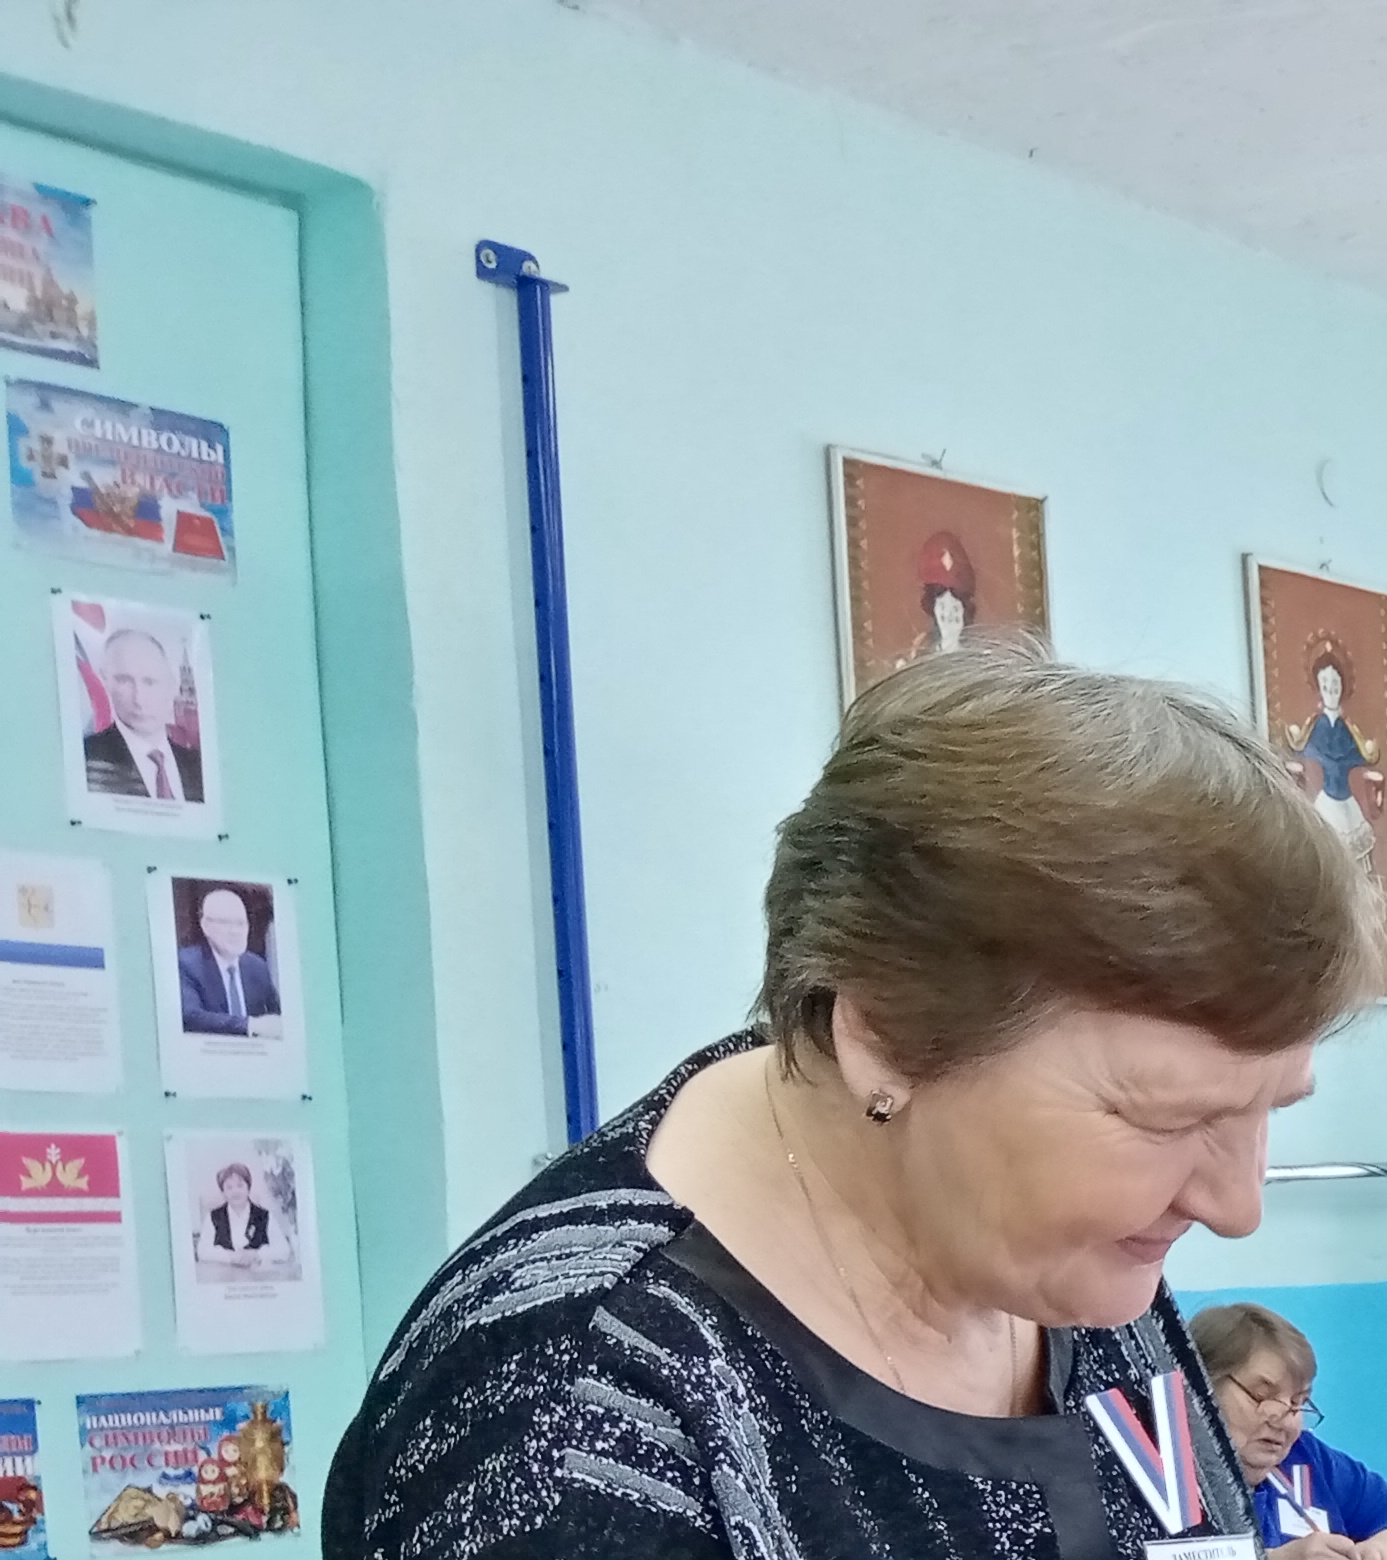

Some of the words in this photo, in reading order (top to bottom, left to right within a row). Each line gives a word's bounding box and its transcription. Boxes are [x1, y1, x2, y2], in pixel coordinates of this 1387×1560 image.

[75, 416, 224, 463] СИМВОЛЫ
[86, 1407, 223, 1430] НАЦИОНАЛЬНЫЕ
[91, 1446, 199, 1474] РОССИИ
